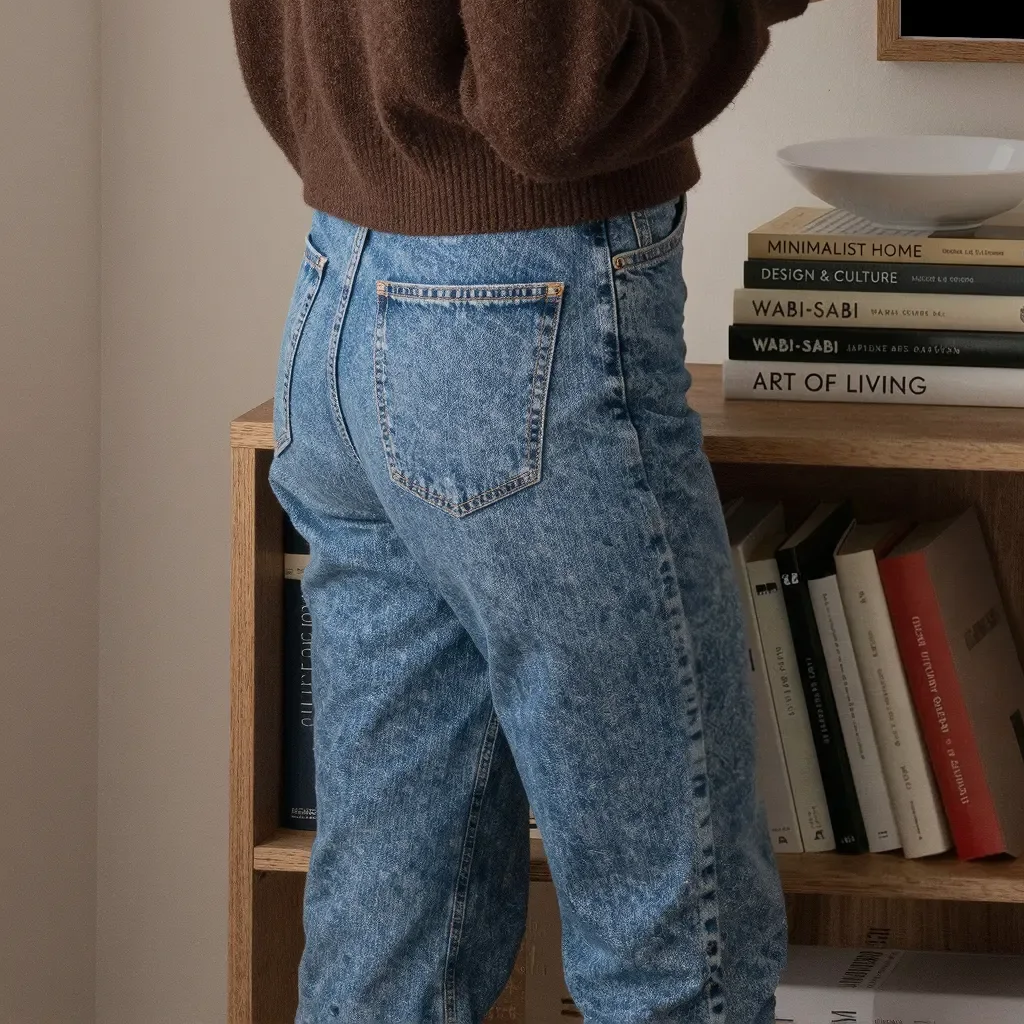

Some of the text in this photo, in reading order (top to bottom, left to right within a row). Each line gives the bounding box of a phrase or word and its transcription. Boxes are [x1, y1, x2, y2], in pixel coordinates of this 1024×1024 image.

[767, 239, 867, 257] MINIMALIST
[871, 242, 923, 259] HOME
[760, 267, 816, 282] DESIGN
[820, 269, 831, 282] &
[834, 269, 898, 285] CULTURE
[752, 299, 859, 319] WABI-SABI
[752, 337, 838, 355] WABI-SABI
[752, 371, 928, 396] ART OF LIVING
